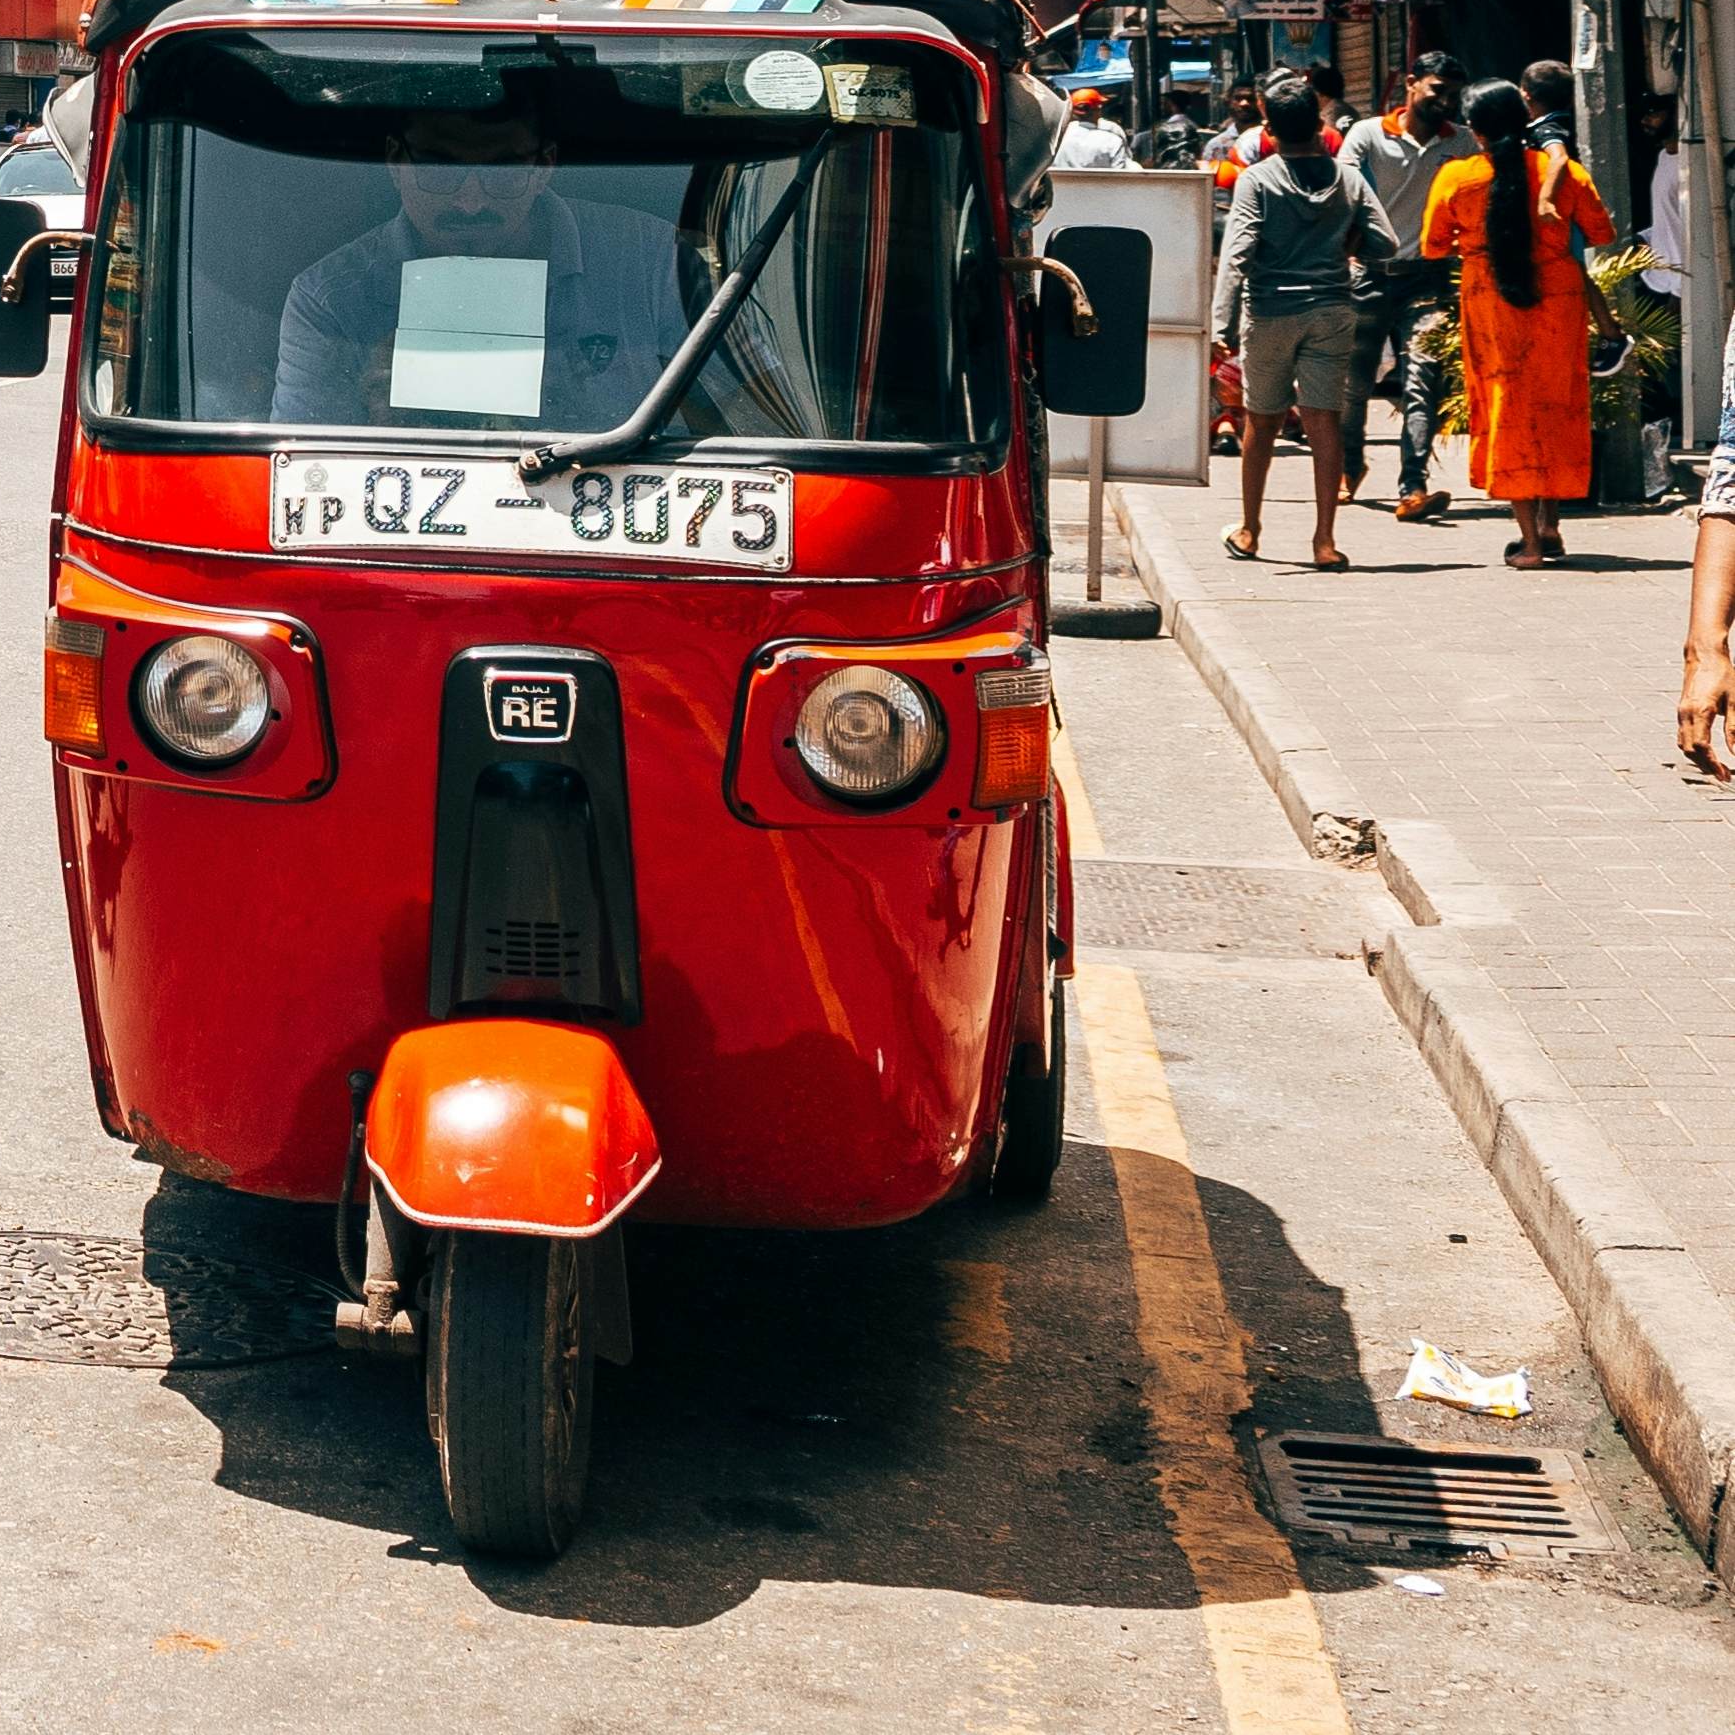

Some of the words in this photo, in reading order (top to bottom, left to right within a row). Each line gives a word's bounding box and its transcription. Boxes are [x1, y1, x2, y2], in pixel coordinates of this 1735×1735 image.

[282, 495, 346, 536] WP
[362, 466, 468, 536] QZ
[570, 472, 778, 552] 8075
[502, 696, 559, 729] RE
